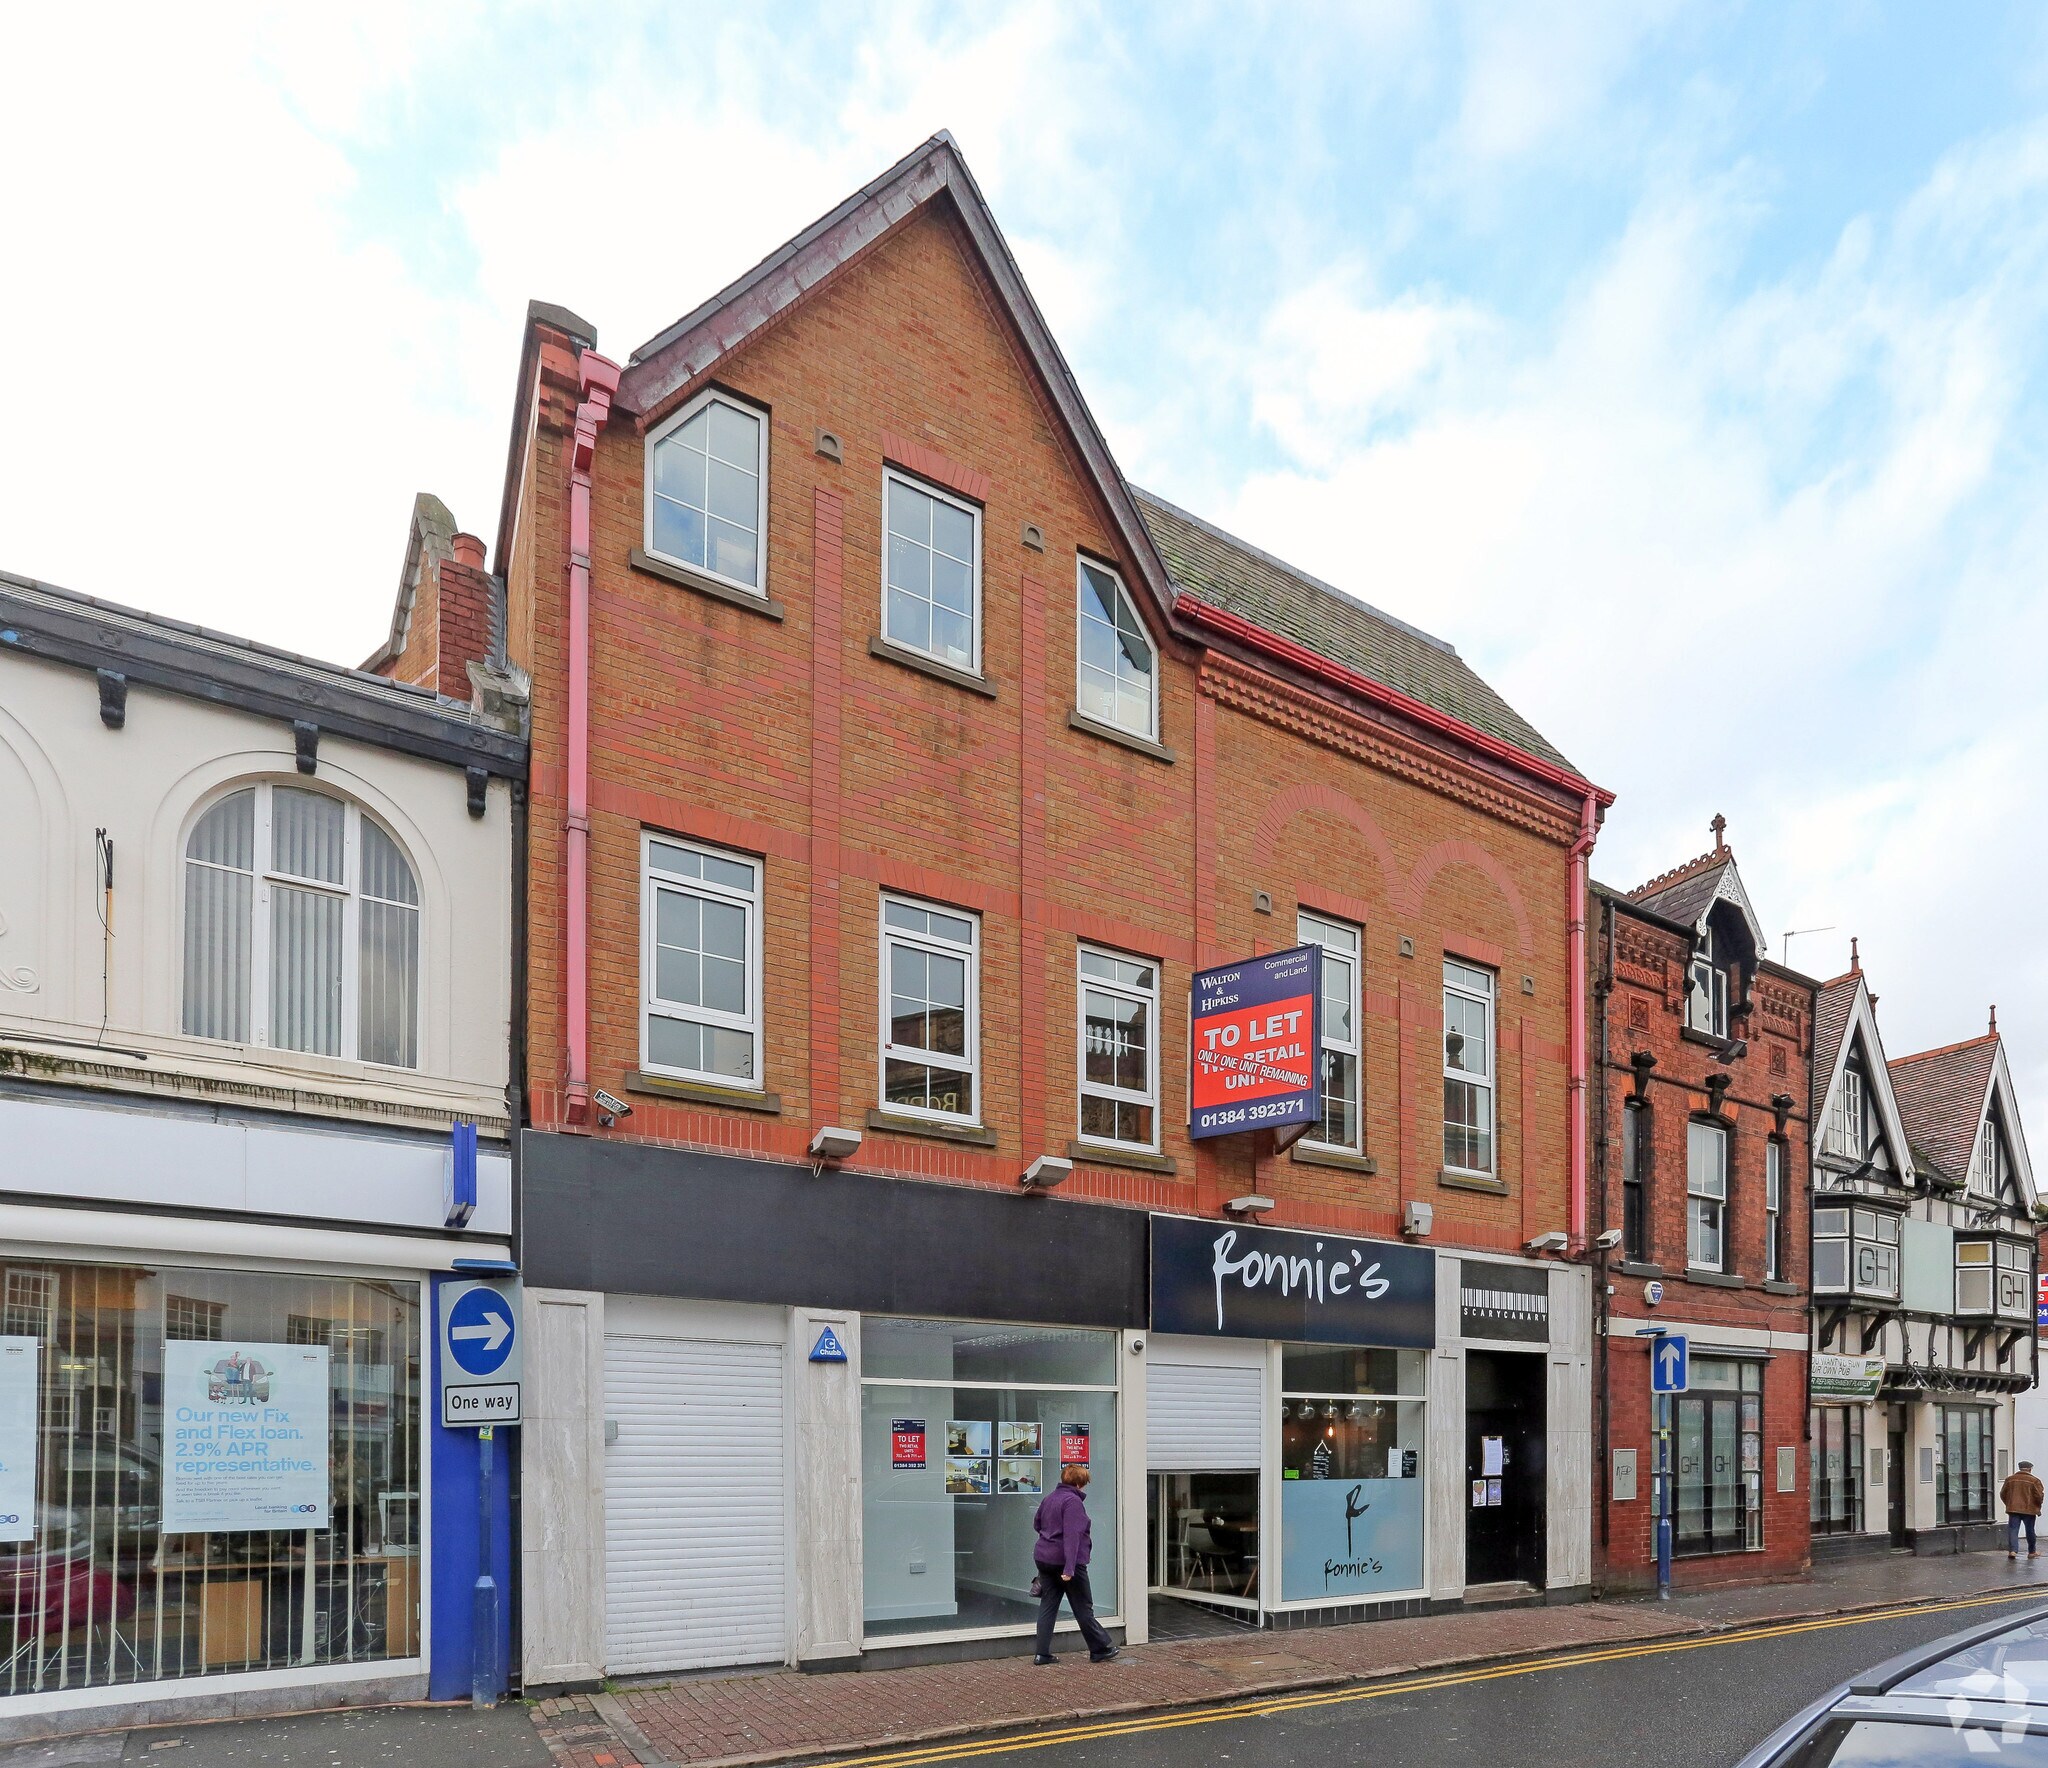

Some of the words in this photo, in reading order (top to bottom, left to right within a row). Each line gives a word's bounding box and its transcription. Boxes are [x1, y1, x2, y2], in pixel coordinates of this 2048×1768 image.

[1264, 953, 1308, 970] Commercial
[1274, 970, 1288, 980] and
[1289, 965, 1308, 977] Land
[1200, 972, 1241, 991] WALTON
[1216, 987, 1224, 996] &
[1201, 994, 1239, 1012] HIPKISS
[1204, 1024, 1240, 1051] TO
[1249, 1010, 1303, 1042] LET
[1198, 1049, 1220, 1064] ONLY
[1220, 1055, 1238, 1069] ONE
[1239, 1060, 1260, 1074] UNIT
[1260, 1065, 1308, 1087] REMAINING
[1201, 1109, 1246, 1128] 01384
[1248, 1098, 1304, 1120] 392371
[1860, 1247, 1890, 1287] GH
[1213, 1230, 1390, 1330] Ronnie's
[2000, 1274, 2024, 1310] GH
[452, 1395, 478, 1409] One
[485, 1396, 512, 1410] way
[176, 1407, 213, 1422] Our
[218, 1412, 258, 1422] new
[264, 1408, 290, 1422] Fix
[176, 1425, 212, 1439] and
[218, 1425, 256, 1439] Flex
[260, 1425, 304, 1439] loan.
[176, 1442, 222, 1457] 2.9%
[226, 1442, 268, 1456] APR
[176, 1458, 316, 1474] representative.
[1681, 1456, 1698, 1473] GH
[1714, 1456, 1730, 1472] GH
[1325, 1557, 1382, 1592] Ronnie's
